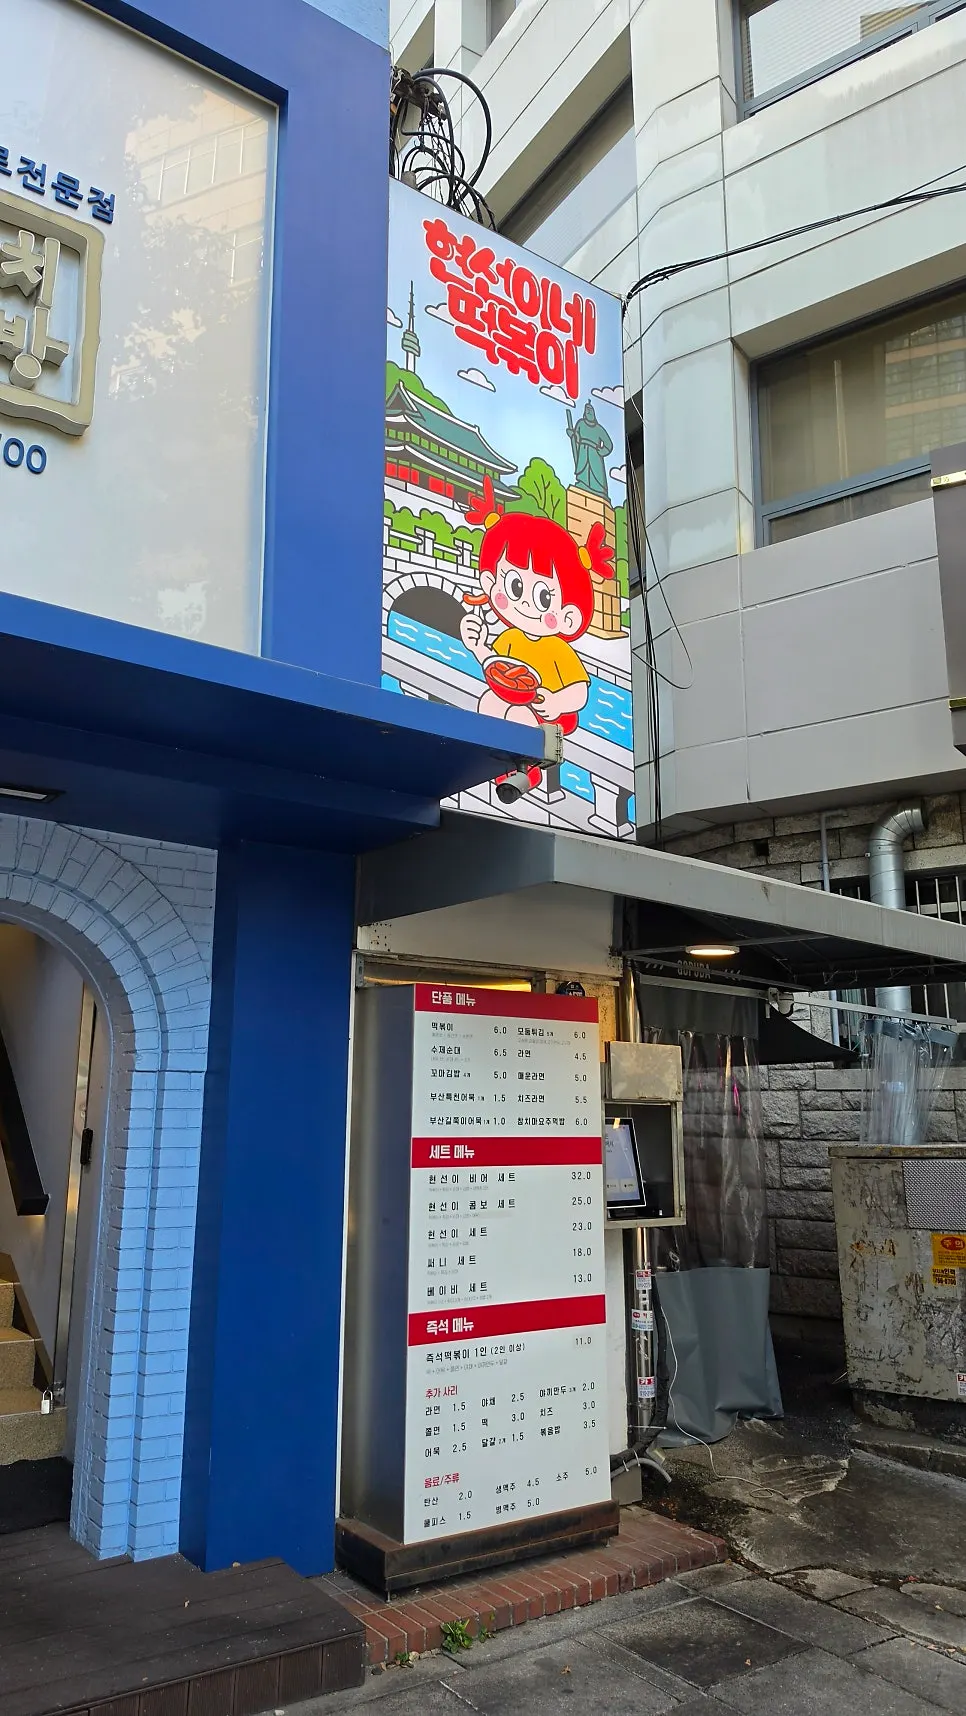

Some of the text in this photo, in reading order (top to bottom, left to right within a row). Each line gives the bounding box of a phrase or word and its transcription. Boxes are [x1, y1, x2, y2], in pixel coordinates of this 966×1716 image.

[422, 217, 597, 355] 현선이네
[446, 283, 580, 400] 떡볶이
[0, 434, 47, 475] 00
[431, 991, 477, 1007] 단품 메뉴
[431, 1021, 507, 1035] 떡볶이 6.0
[573, 1031, 586, 1039] 6.0
[431, 1045, 507, 1057] 수제순대 6.5
[517, 1049, 587, 1061] 라면 4.5
[431, 1068, 461, 1078] 꼬마김밥
[493, 1070, 507, 1080] 5.0
[517, 1071, 587, 1082] 매운라면 5.0
[493, 1093, 506, 1103] 1.5
[517, 1094, 588, 1104] 치즈라면 5.5
[493, 1117, 506, 1126] 1.0
[517, 1117, 588, 1126] 참치마요주먹밥 6.0
[428, 1145, 475, 1160] 세트 메뉴
[428, 1171, 591, 1185] 현선이 비어 세트 32.0
[428, 1196, 592, 1212] 현선이 콤보 세트 25.0
[427, 1221, 592, 1239] 현선이 세트 23.0
[457, 1254, 477, 1265] 세트
[573, 1247, 592, 1257] 18.0
[427, 1273, 592, 1296] 베이비 세트 13.0
[426, 1317, 475, 1336] 즉석 메뉴
[426, 1336, 592, 1363] 즉석떡볶이 1인 (2인 이상) 11.0
[425, 1385, 458, 1398] 추가 사리
[425, 1405, 441, 1416] 라면
[452, 1401, 466, 1412] 1.5
[481, 1396, 496, 1407] 야채
[511, 1392, 525, 1403] 2.5
[539, 1385, 567, 1397] 야끼만두
[582, 1381, 595, 1392] 2.0
[425, 1400, 596, 1437] 쫄면 1.5 떡 3.0 치즈 3.0
[424, 1446, 440, 1457] 어묵
[452, 1442, 467, 1453] 2.5
[481, 1436, 496, 1447] 달걀
[512, 1431, 524, 1442] 1.5
[540, 1425, 561, 1436] 볶음밥
[583, 1419, 596, 1429] 3.5
[423, 1465, 598, 1507] 탄산 2.0 생맥주 4.5 소주 5.0
[425, 1472, 459, 1489] 음료/주류
[459, 1510, 472, 1521] 1.5
[495, 1502, 516, 1514] 병맥주
[527, 1497, 540, 1508] 5.0
